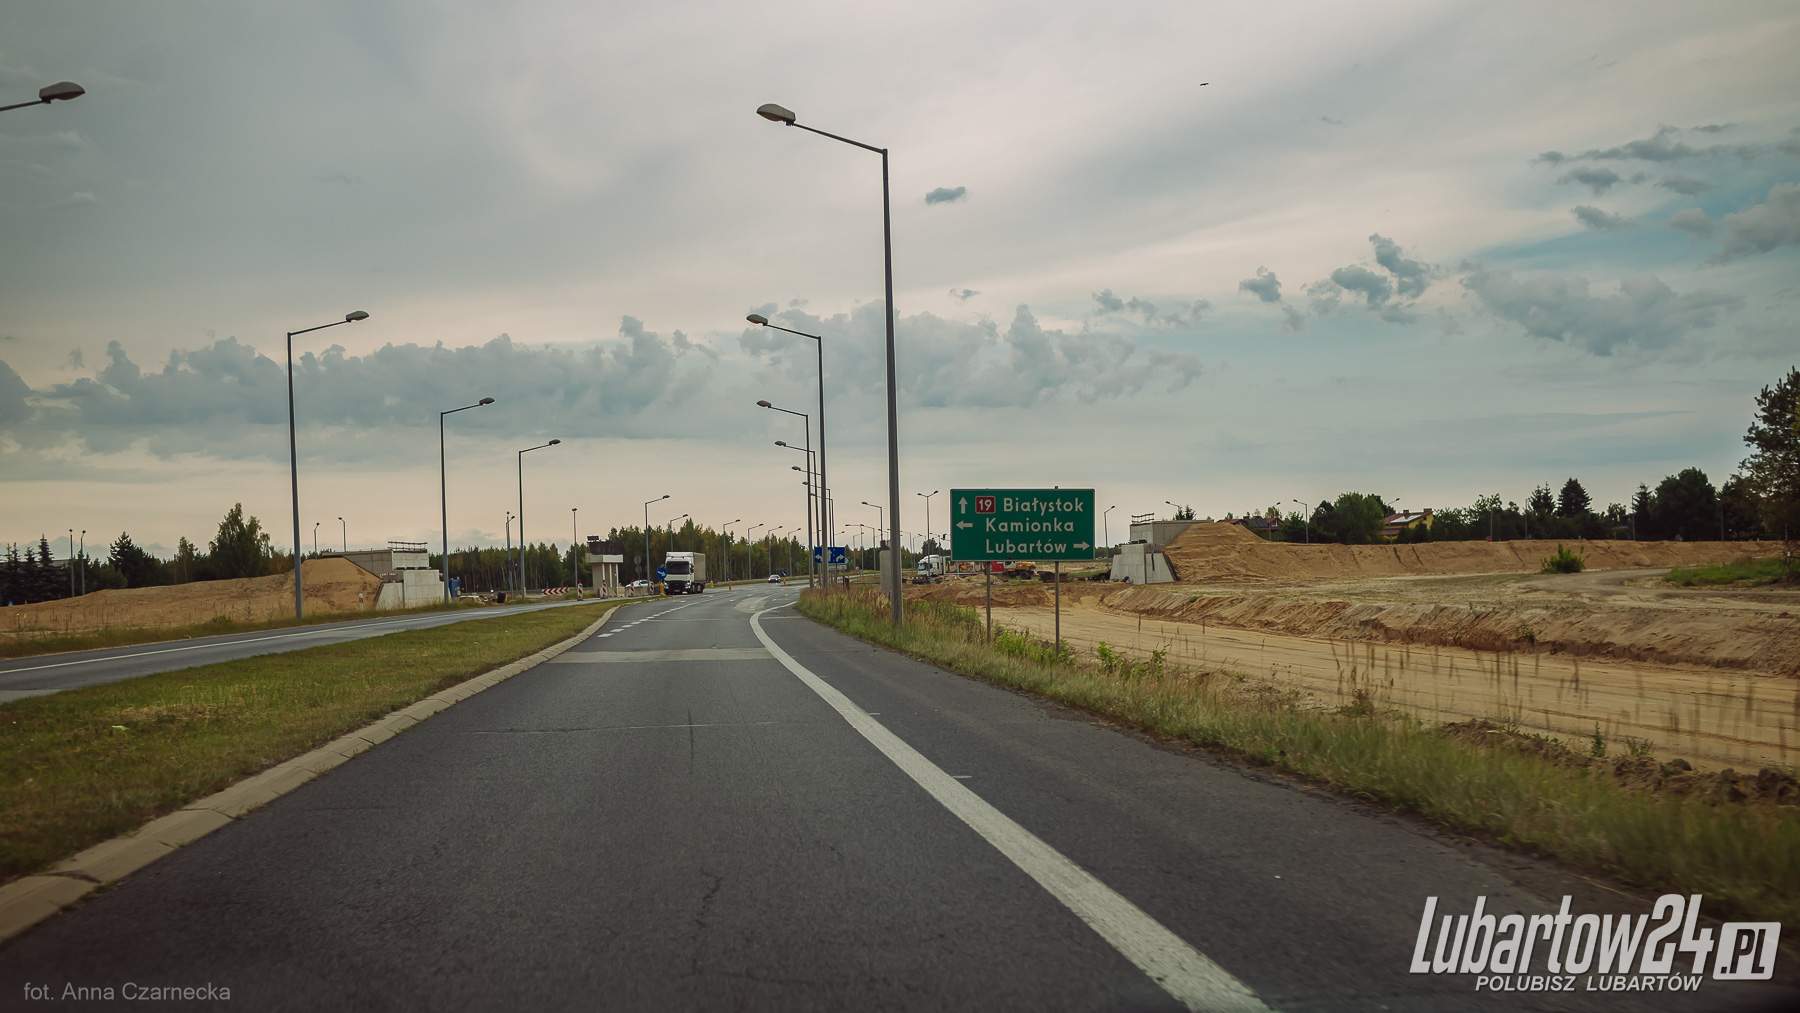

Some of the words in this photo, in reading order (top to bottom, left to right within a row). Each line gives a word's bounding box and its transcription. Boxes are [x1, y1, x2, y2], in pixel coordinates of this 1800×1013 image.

[977, 499, 992, 511] 19
[1003, 497, 1084, 515] Białystok
[985, 517, 1074, 532] Kamionka
[985, 538, 1067, 553] Lubartów
